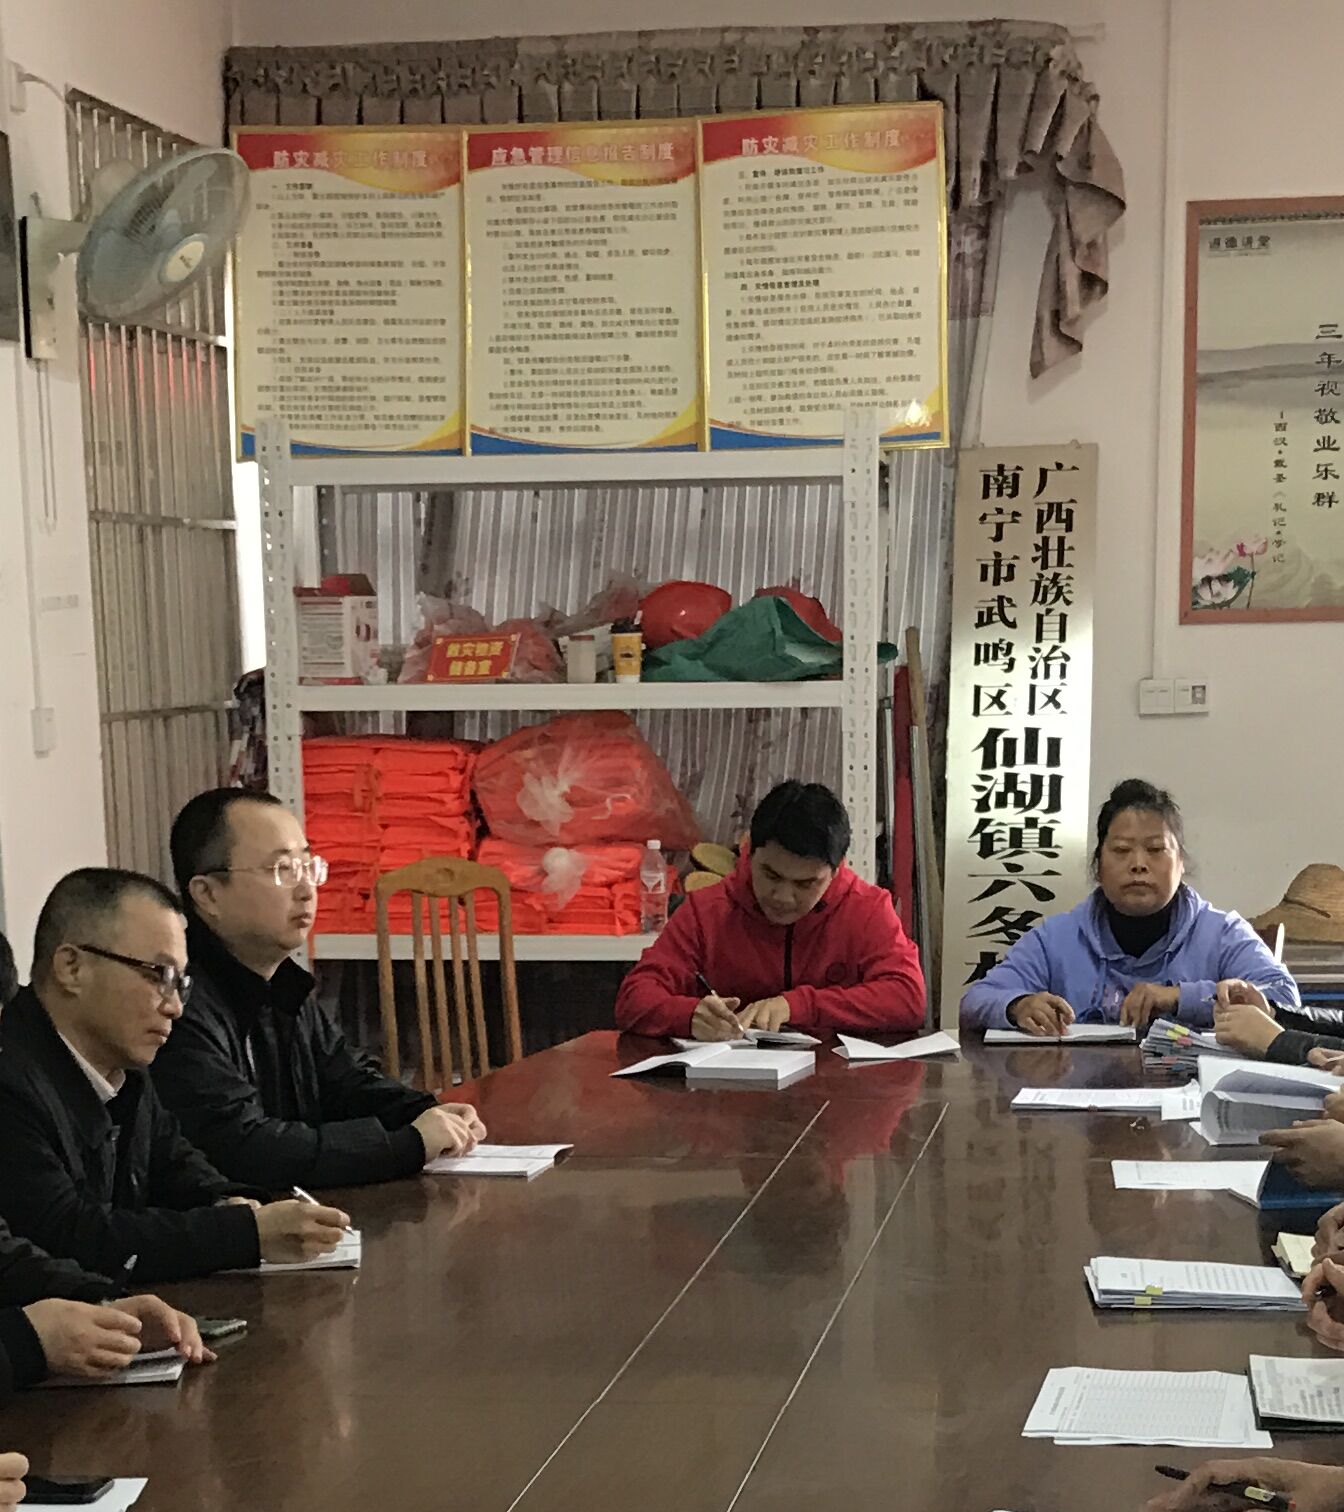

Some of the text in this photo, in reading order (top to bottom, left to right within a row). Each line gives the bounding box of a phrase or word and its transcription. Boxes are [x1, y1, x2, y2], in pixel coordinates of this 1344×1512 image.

[491, 141, 676, 168] 应急管理信息报告制度
[741, 129, 901, 156] 防灾减灾工作制度
[1311, 323, 1344, 509] 三年视敬业乐群
[971, 463, 1024, 718] 南宁市武鸣区
[1026, 461, 1080, 717] 广西壮族自治区
